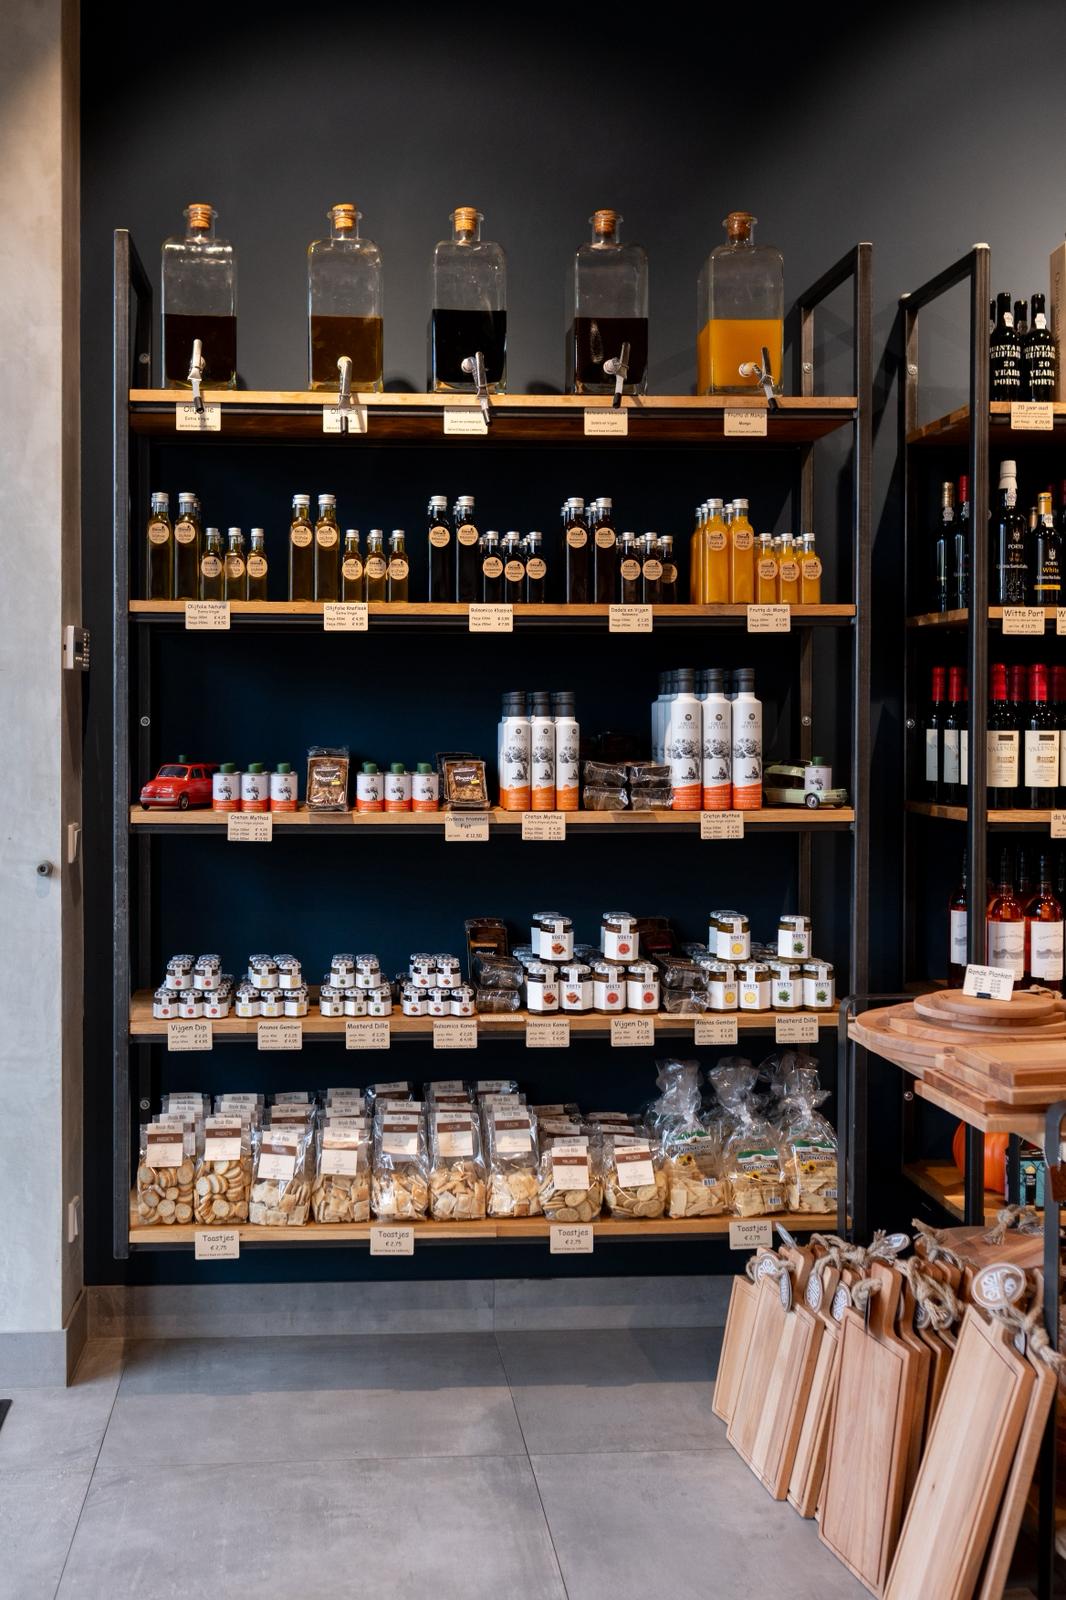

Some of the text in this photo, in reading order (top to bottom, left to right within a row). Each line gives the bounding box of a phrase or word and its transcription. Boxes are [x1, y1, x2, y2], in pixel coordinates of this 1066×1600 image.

[1004, 609, 1043, 617] Witte Port
[988, 970, 1013, 980] Planken
[171, 1024, 207, 1033] Vijgen Dip
[614, 1020, 649, 1029] Vijgen Dip
[557, 1229, 589, 1238] Toastjes
[737, 1225, 768, 1234] Toastjes
[202, 1234, 235, 1243] Toastjes
[377, 1230, 410, 1239] Toastjes
